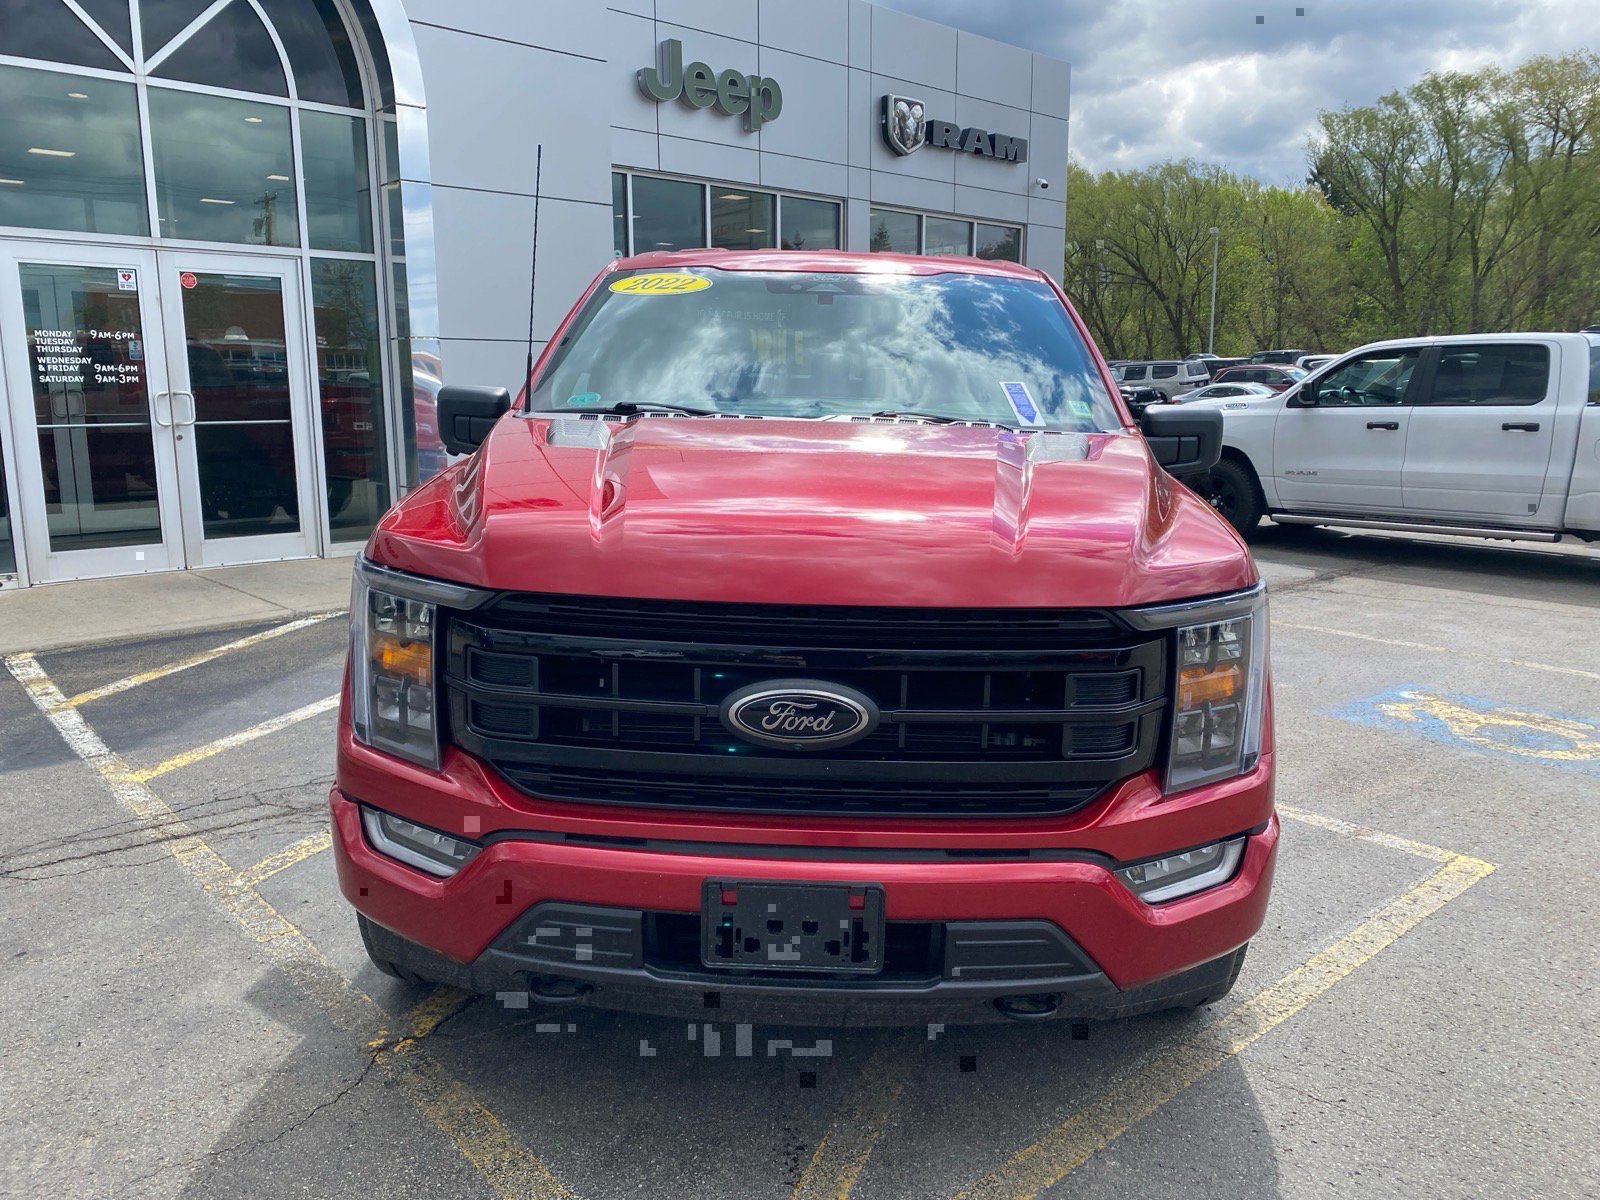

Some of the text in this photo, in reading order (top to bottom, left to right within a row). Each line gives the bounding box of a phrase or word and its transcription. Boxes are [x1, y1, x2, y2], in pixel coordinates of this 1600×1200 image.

[636, 38, 783, 132] Jeep
[925, 119, 1028, 163] RAM
[623, 277, 698, 290] 2022
[34, 329, 72, 338] MONDAY
[35, 337, 74, 345] TUESDAY
[36, 345, 83, 353] THURSDAY
[37, 356, 92, 364] WEDNESDAY
[38, 363, 138, 373] & FRIDAY 9AM-6PM
[39, 374, 139, 384] SATURDAY 9AM-3PM
[761, 701, 836, 732] Ford
